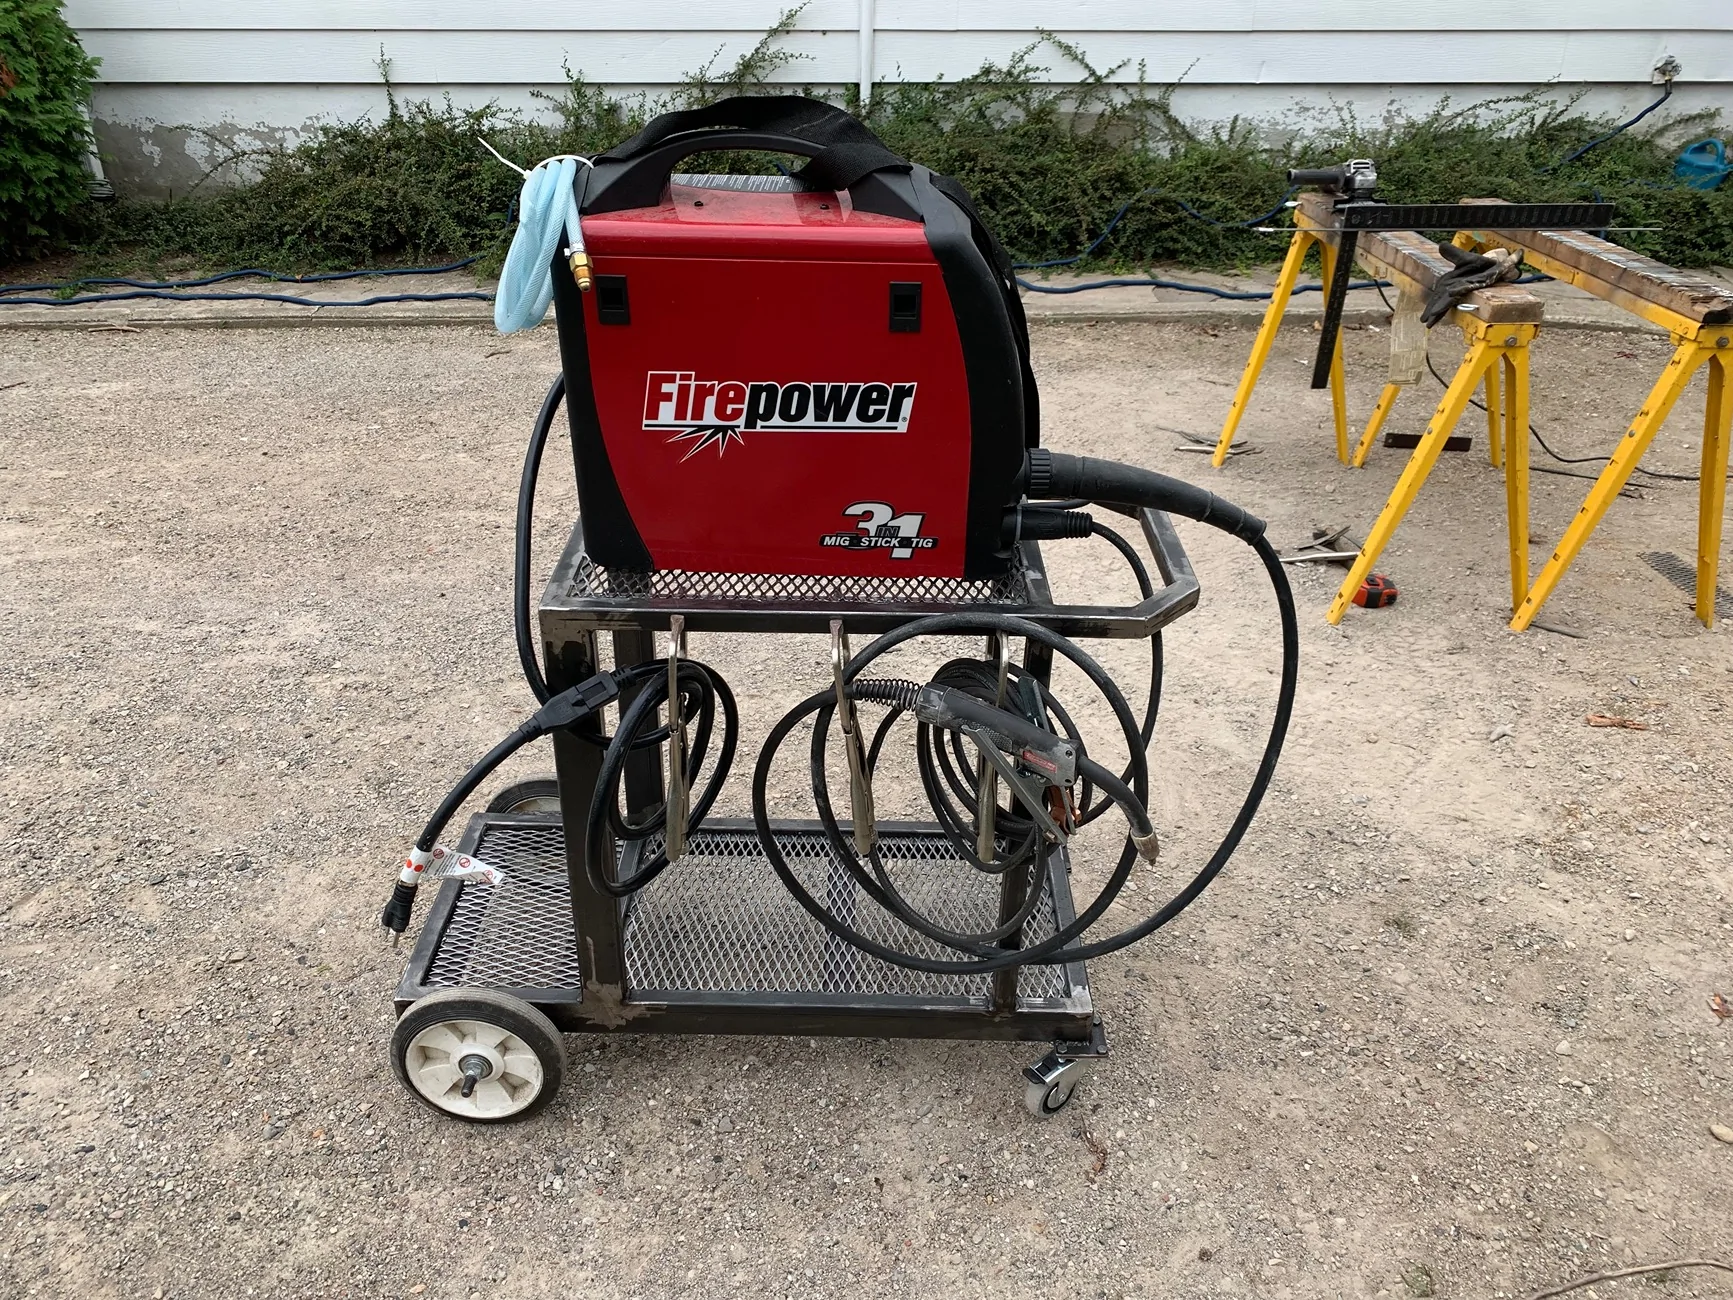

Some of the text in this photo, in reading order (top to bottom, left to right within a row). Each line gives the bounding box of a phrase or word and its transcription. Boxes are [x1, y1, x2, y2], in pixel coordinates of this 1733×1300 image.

[823, 536, 933, 548] MIG STICK TIG
[843, 502, 923, 558] 3 IN 1
